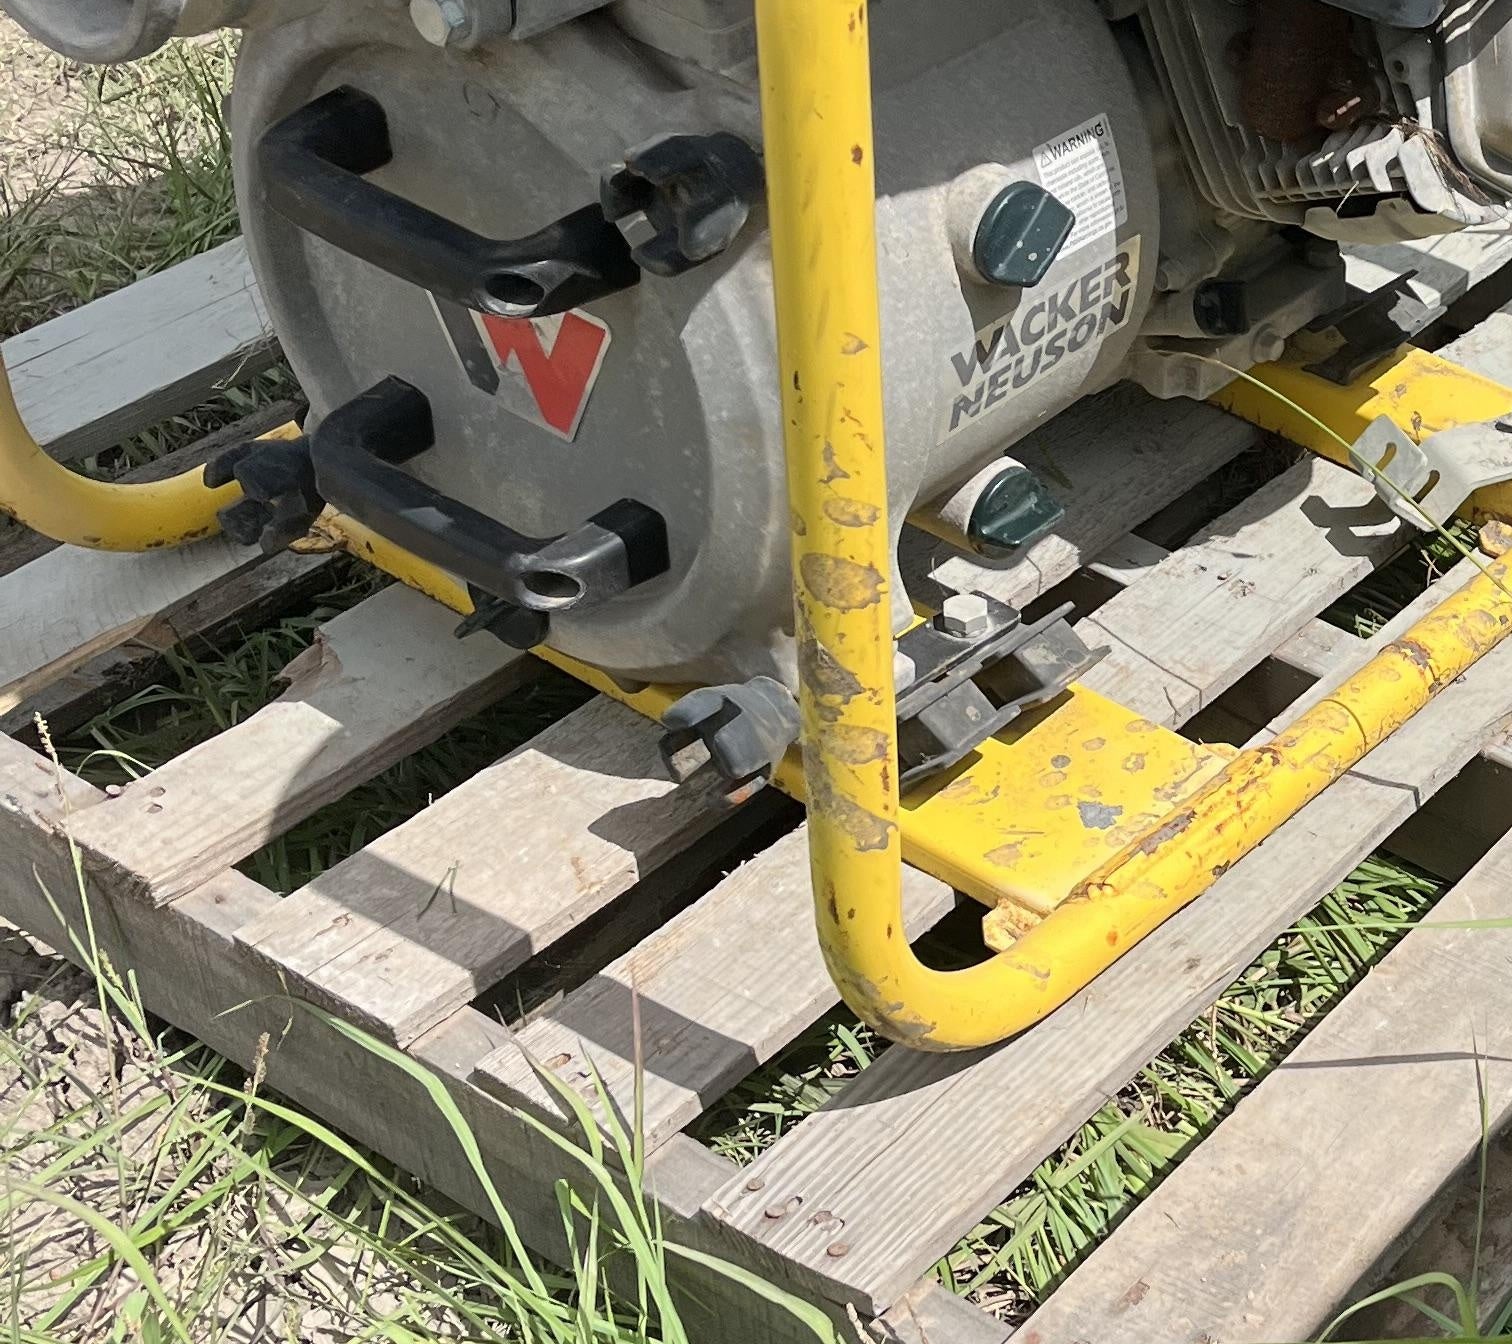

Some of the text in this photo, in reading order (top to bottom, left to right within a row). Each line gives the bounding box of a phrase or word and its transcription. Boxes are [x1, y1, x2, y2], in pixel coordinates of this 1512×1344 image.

[1047, 122, 1104, 160] WARNING
[948, 288, 1130, 432] NEUSON
[951, 251, 1131, 387] WACKER
